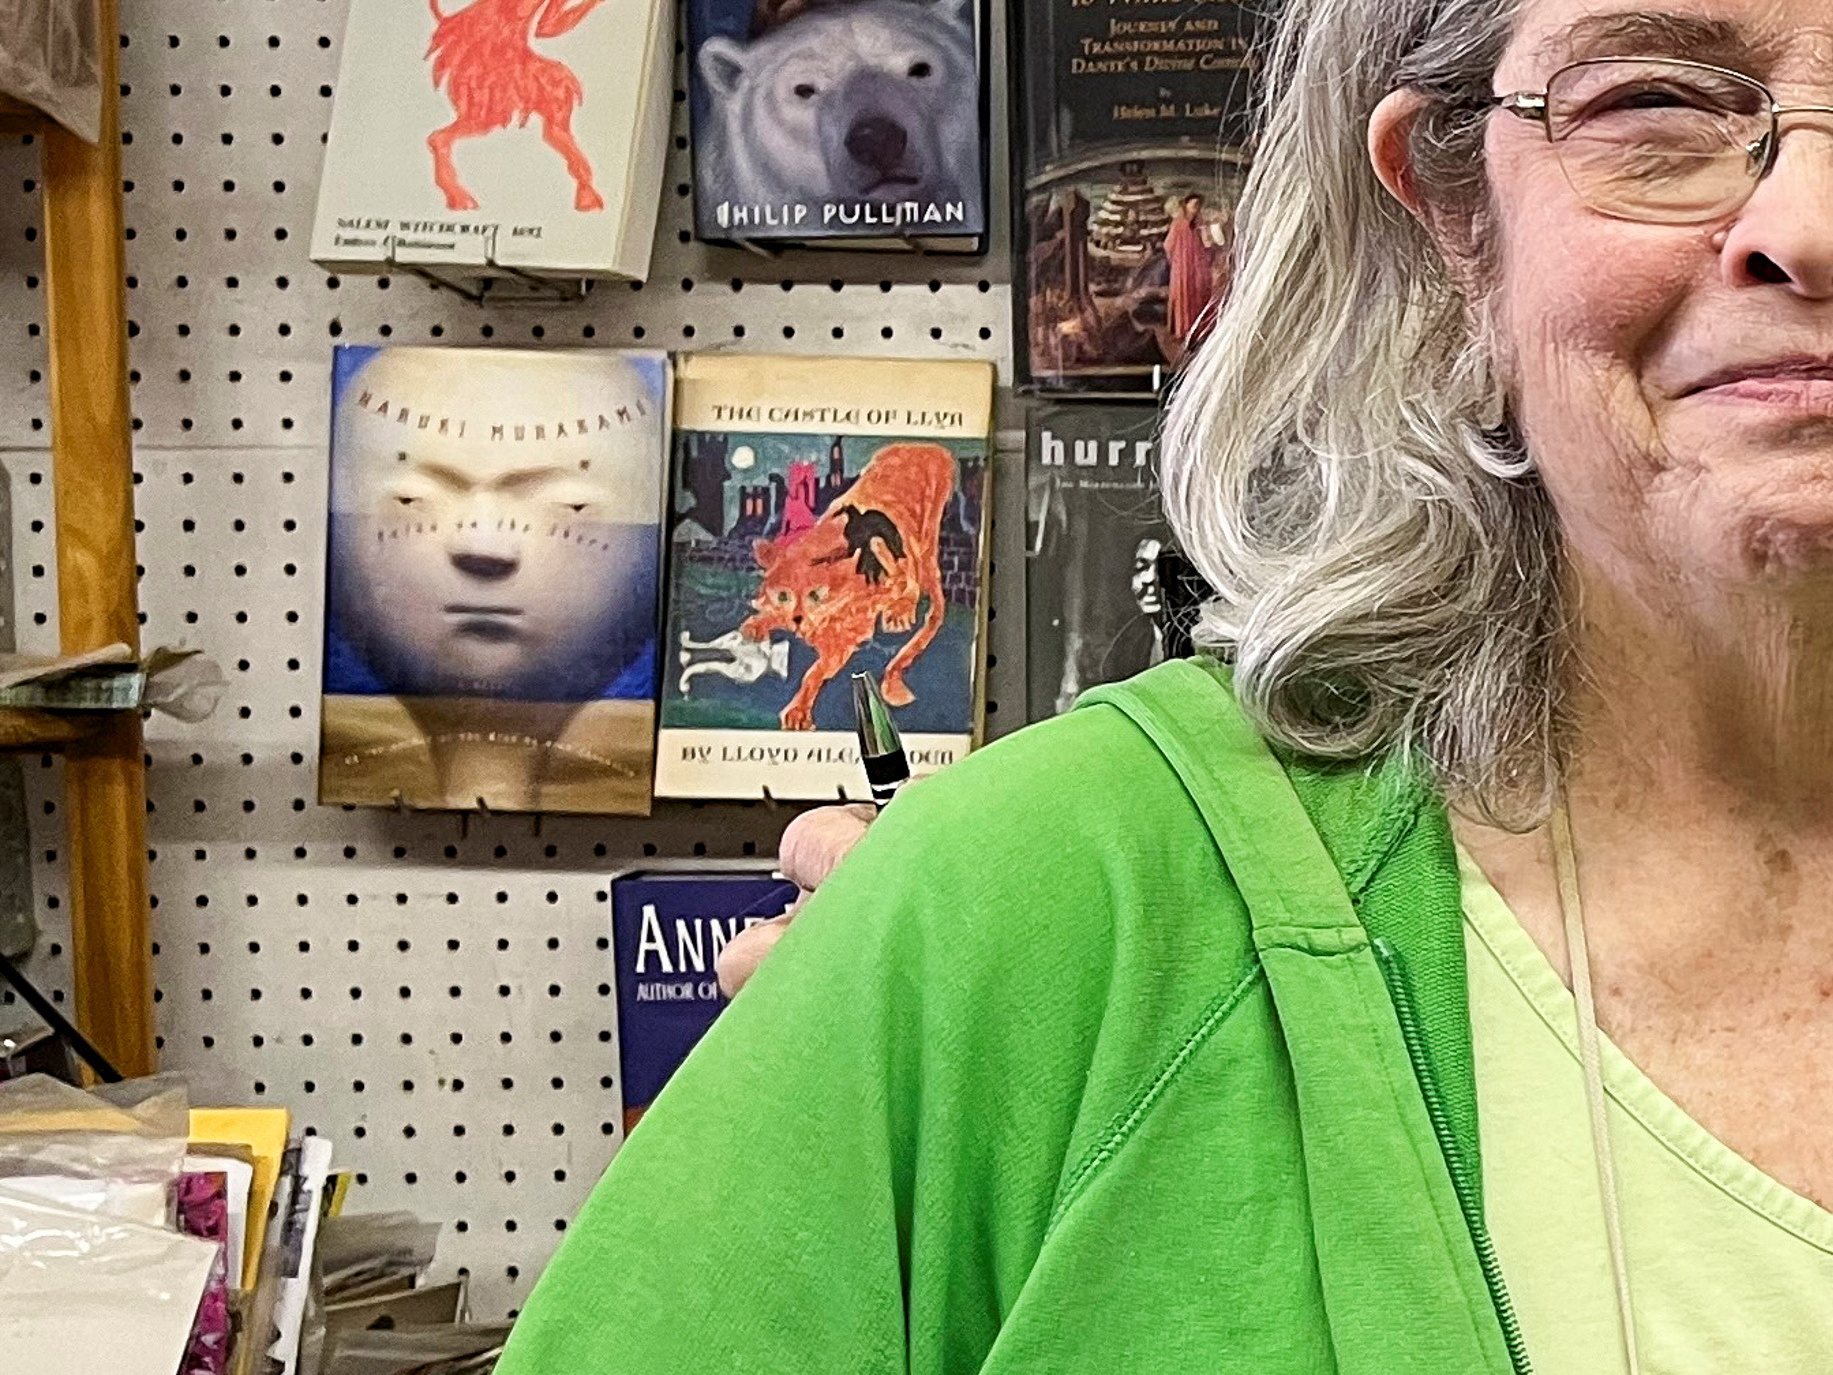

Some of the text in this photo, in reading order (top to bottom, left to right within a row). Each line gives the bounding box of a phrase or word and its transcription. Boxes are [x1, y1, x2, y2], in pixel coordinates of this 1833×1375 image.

[1183, 17, 1220, 33] AND
[1080, 37, 1225, 56] TRANSFORMATION
[716, 199, 965, 227] PHILIP PULLMAN
[711, 405, 898, 425] THE CASTLE OF
[721, 745, 800, 764] LLOYD
[636, 982, 695, 1002] AUTHOR
